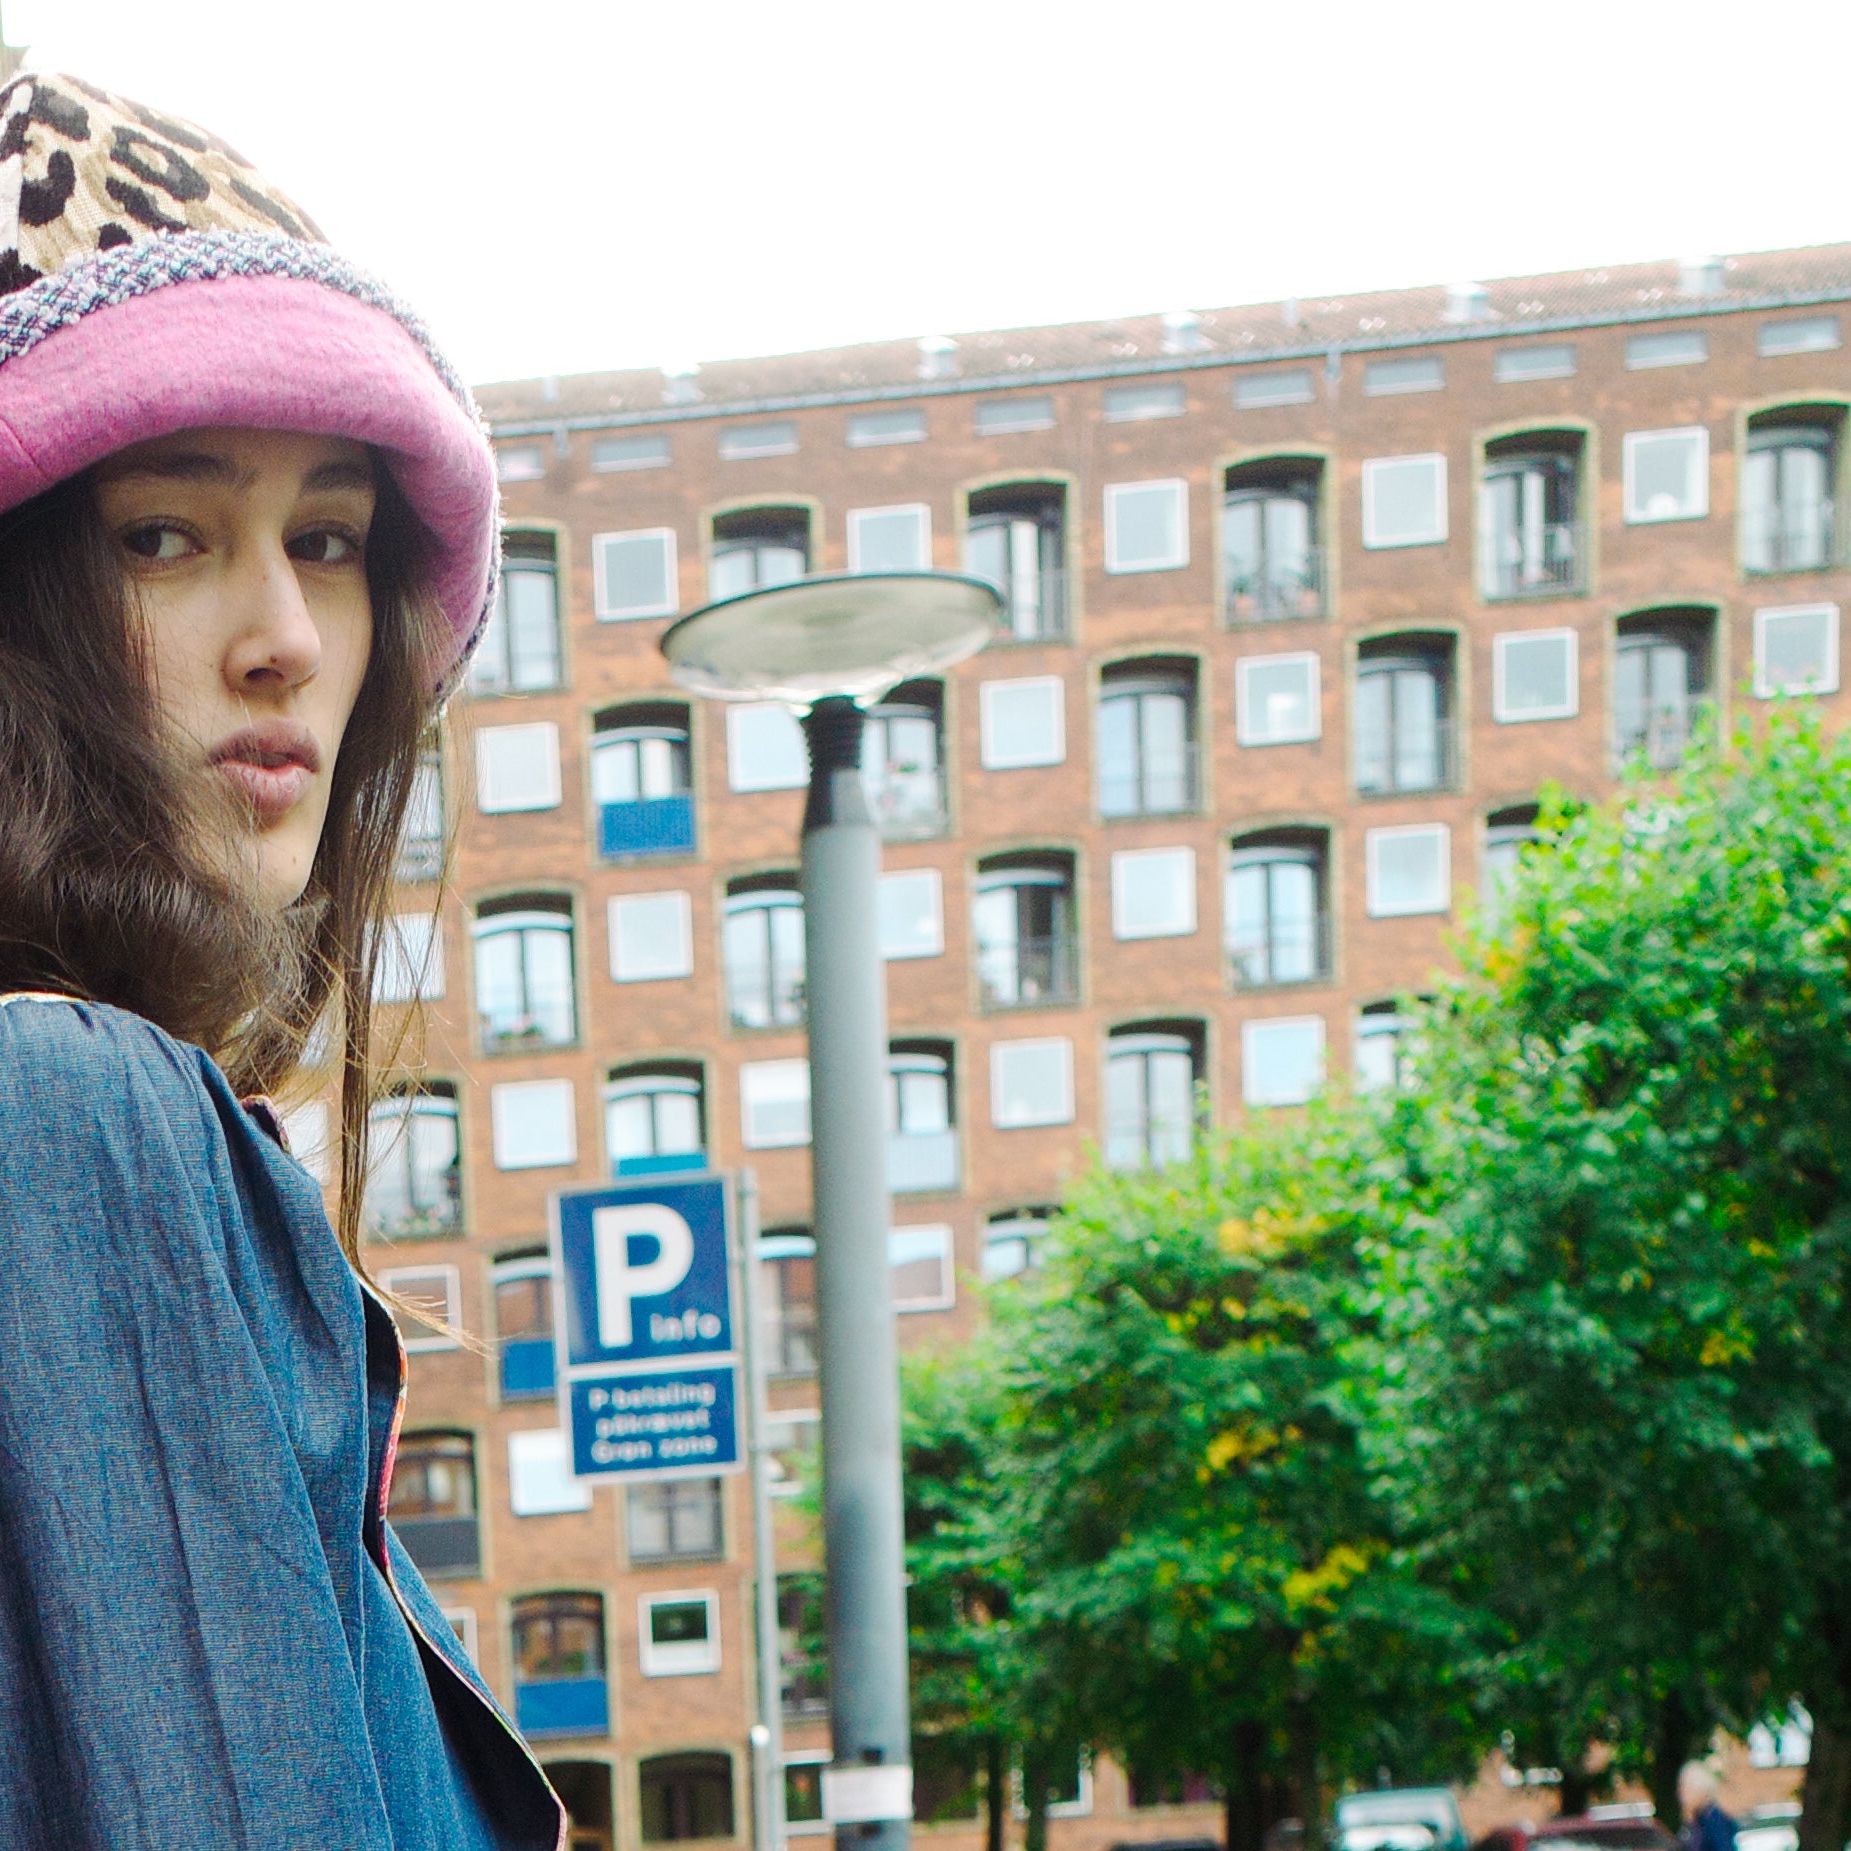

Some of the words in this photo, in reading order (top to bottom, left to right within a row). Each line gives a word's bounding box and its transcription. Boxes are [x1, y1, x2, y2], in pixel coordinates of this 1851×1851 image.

[592, 1203, 694, 1348] P
[650, 1308, 721, 1343] info
[589, 1387, 609, 1411] P
